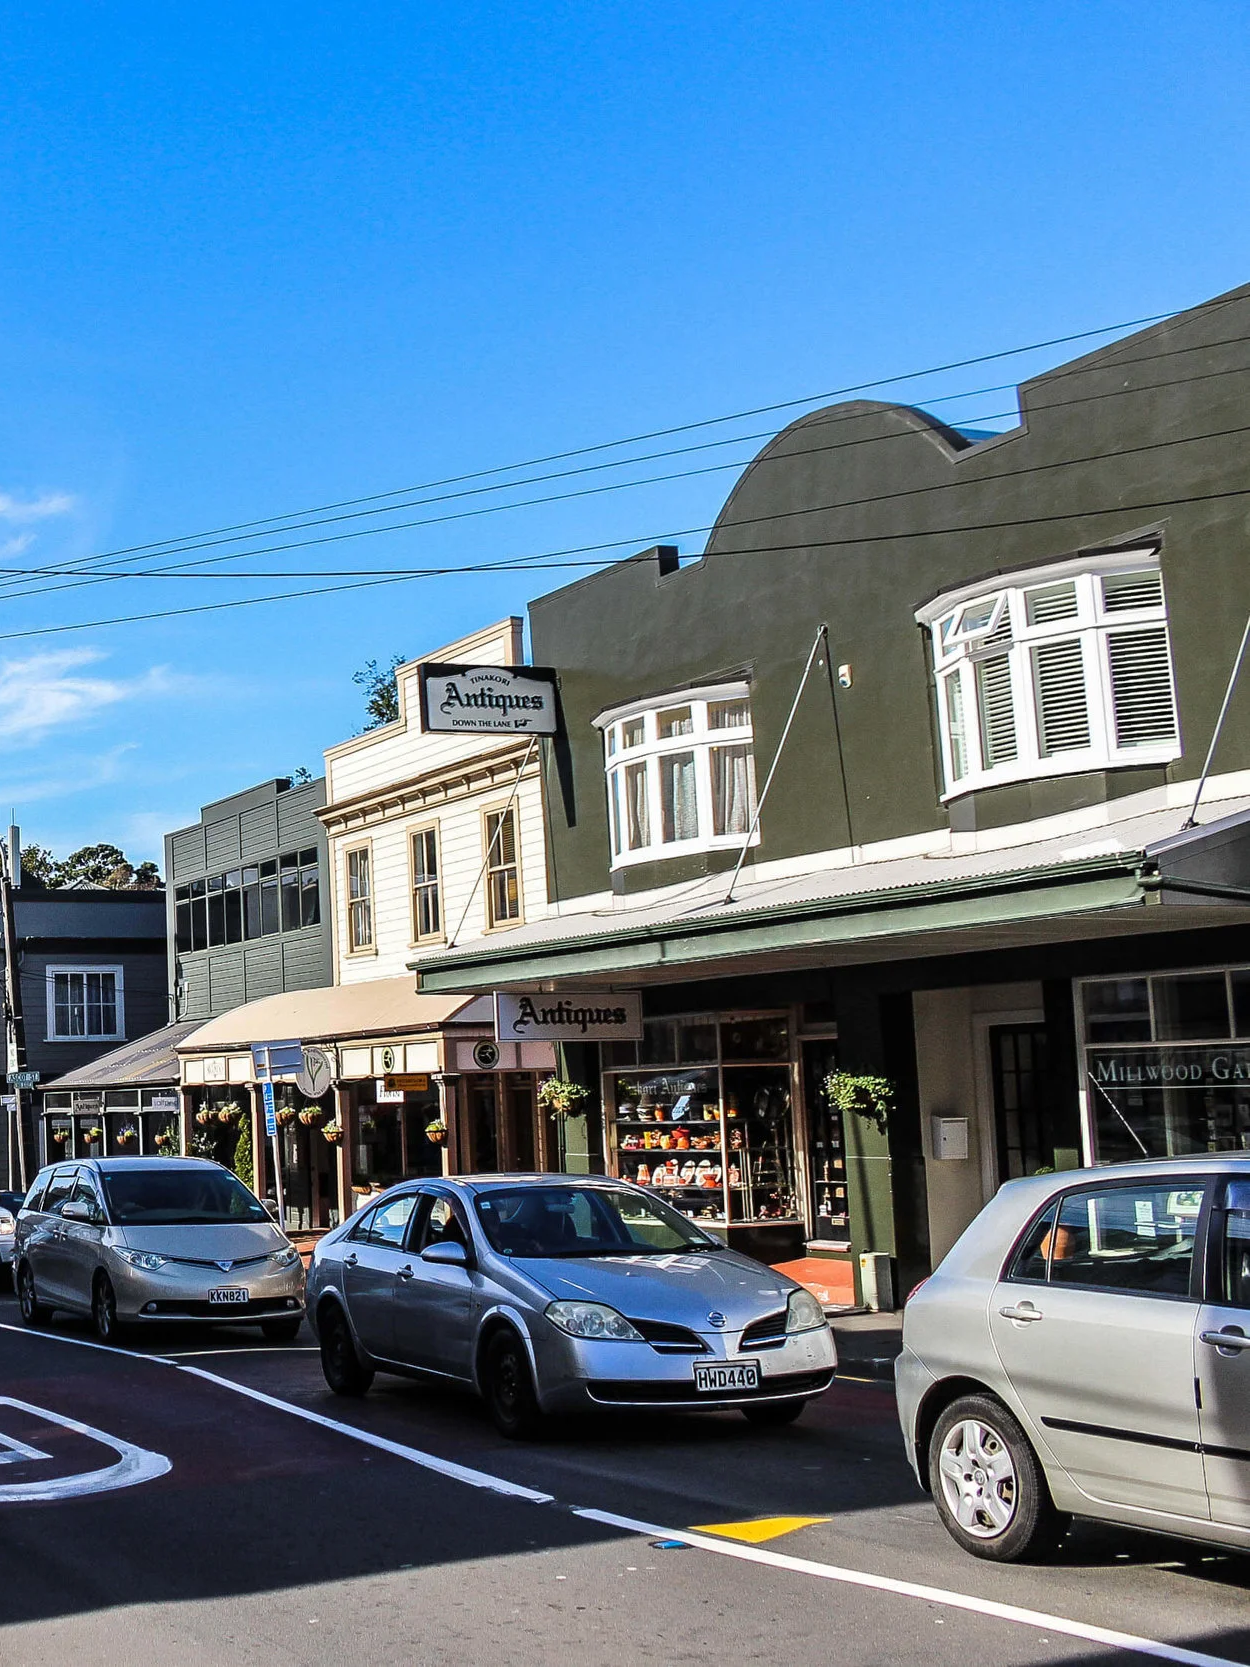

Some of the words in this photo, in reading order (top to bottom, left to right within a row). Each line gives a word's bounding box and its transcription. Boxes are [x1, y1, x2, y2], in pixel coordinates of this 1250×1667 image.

[470, 674, 510, 686] TINAKORI
[440, 682, 544, 717] Antiques
[451, 719, 477, 727] DOWN
[493, 720, 511, 728] LANE
[512, 996, 628, 1033] Antiques
[210, 1291, 247, 1302] KKN821
[699, 1369, 756, 1388] HWD440
